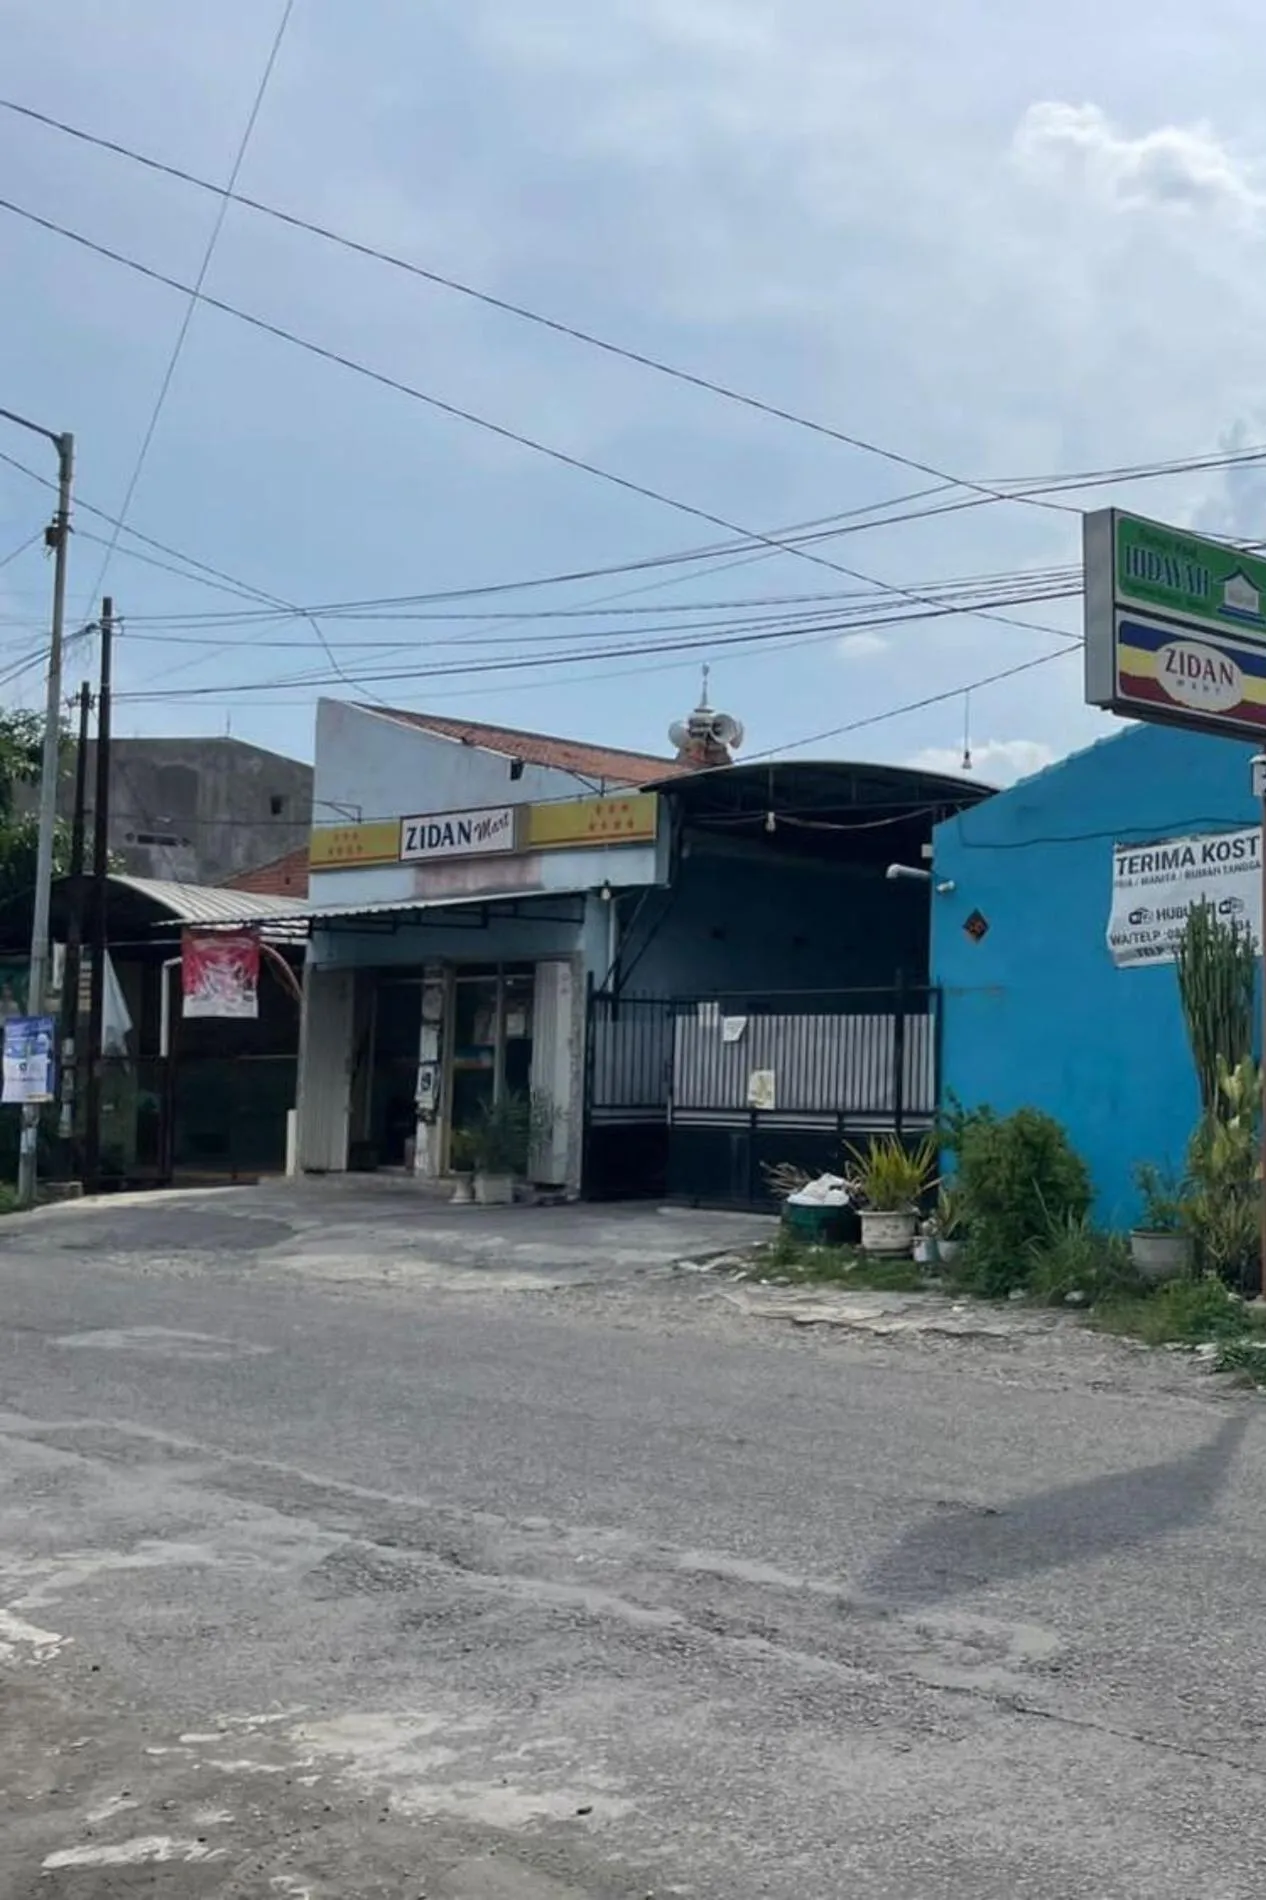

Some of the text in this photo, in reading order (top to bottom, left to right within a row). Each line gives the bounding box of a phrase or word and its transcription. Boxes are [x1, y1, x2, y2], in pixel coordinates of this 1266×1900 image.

[1165, 647, 1234, 686] ZIDAN
[405, 819, 473, 852] ZIDAN
[1116, 835, 1261, 876] TERIMA KOST
